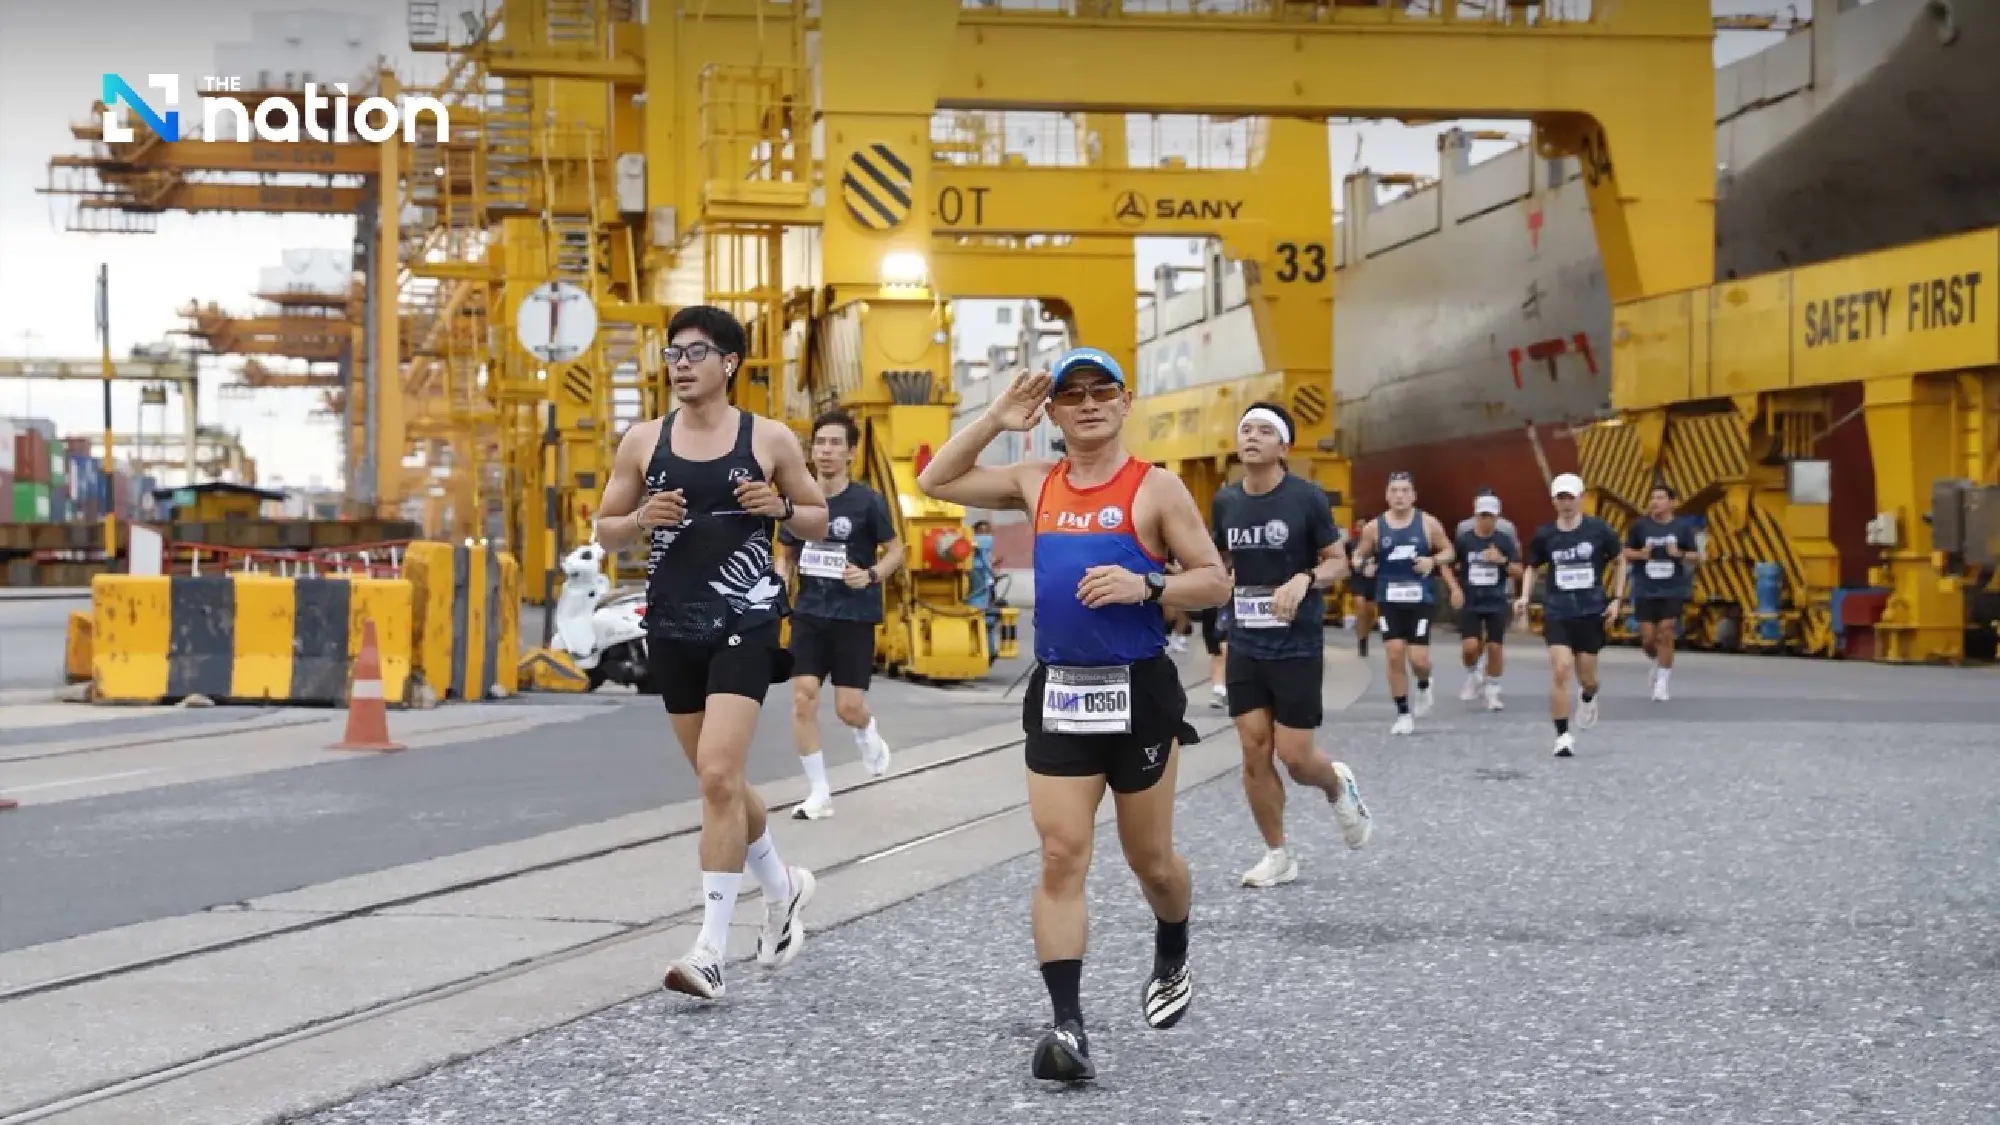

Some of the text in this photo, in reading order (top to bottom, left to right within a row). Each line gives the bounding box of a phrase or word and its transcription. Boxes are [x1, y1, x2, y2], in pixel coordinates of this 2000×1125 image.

[1155, 198, 1244, 220] SANY
[1276, 242, 1326, 283] 33
[1804, 271, 1982, 349] SAFETY FIRST
[1084, 690, 1127, 713] 0350
